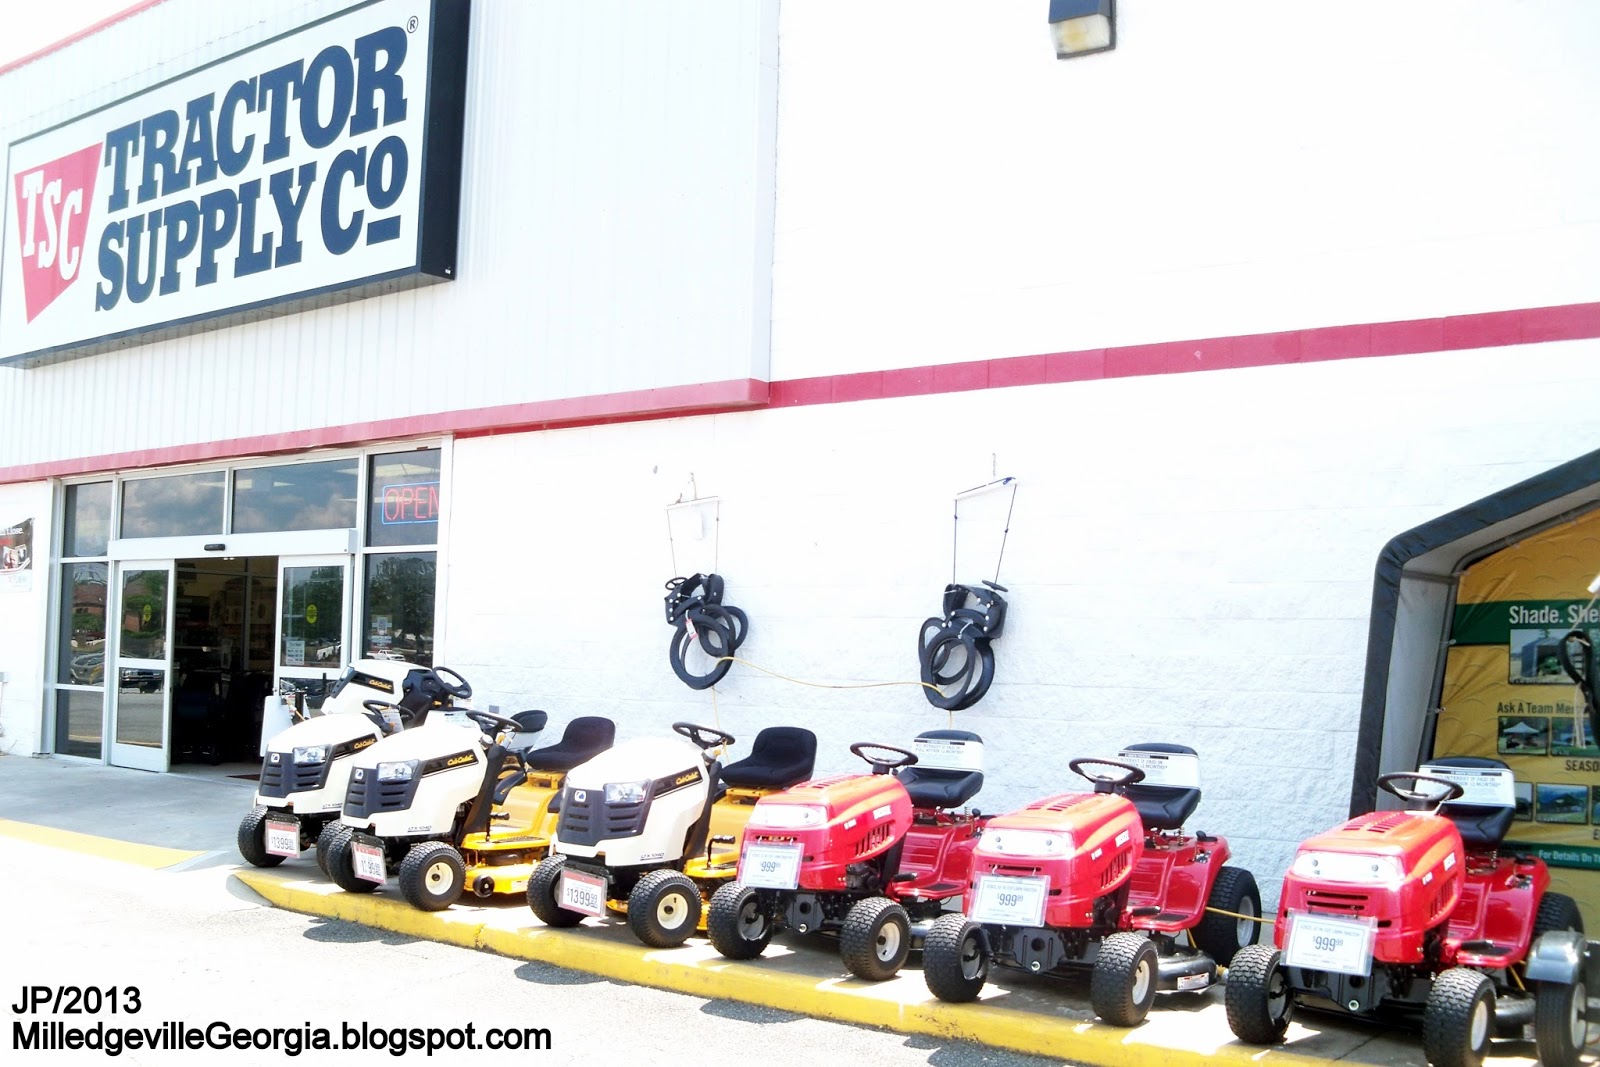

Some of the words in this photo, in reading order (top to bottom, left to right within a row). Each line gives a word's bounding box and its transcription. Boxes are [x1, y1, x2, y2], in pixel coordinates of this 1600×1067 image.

[104, 26, 408, 213] TRACTOR
[22, 169, 82, 280] TSC
[95, 161, 318, 312] SUPPLY
[1509, 605, 1563, 624] Shade.
[1567, 604, 1600, 623] She
[1497, 702, 1516, 714] Ask
[1517, 703, 1524, 713] A
[1526, 703, 1554, 714] Team
[1539, 849, 1551, 859] For
[1552, 850, 1580, 862] Details
